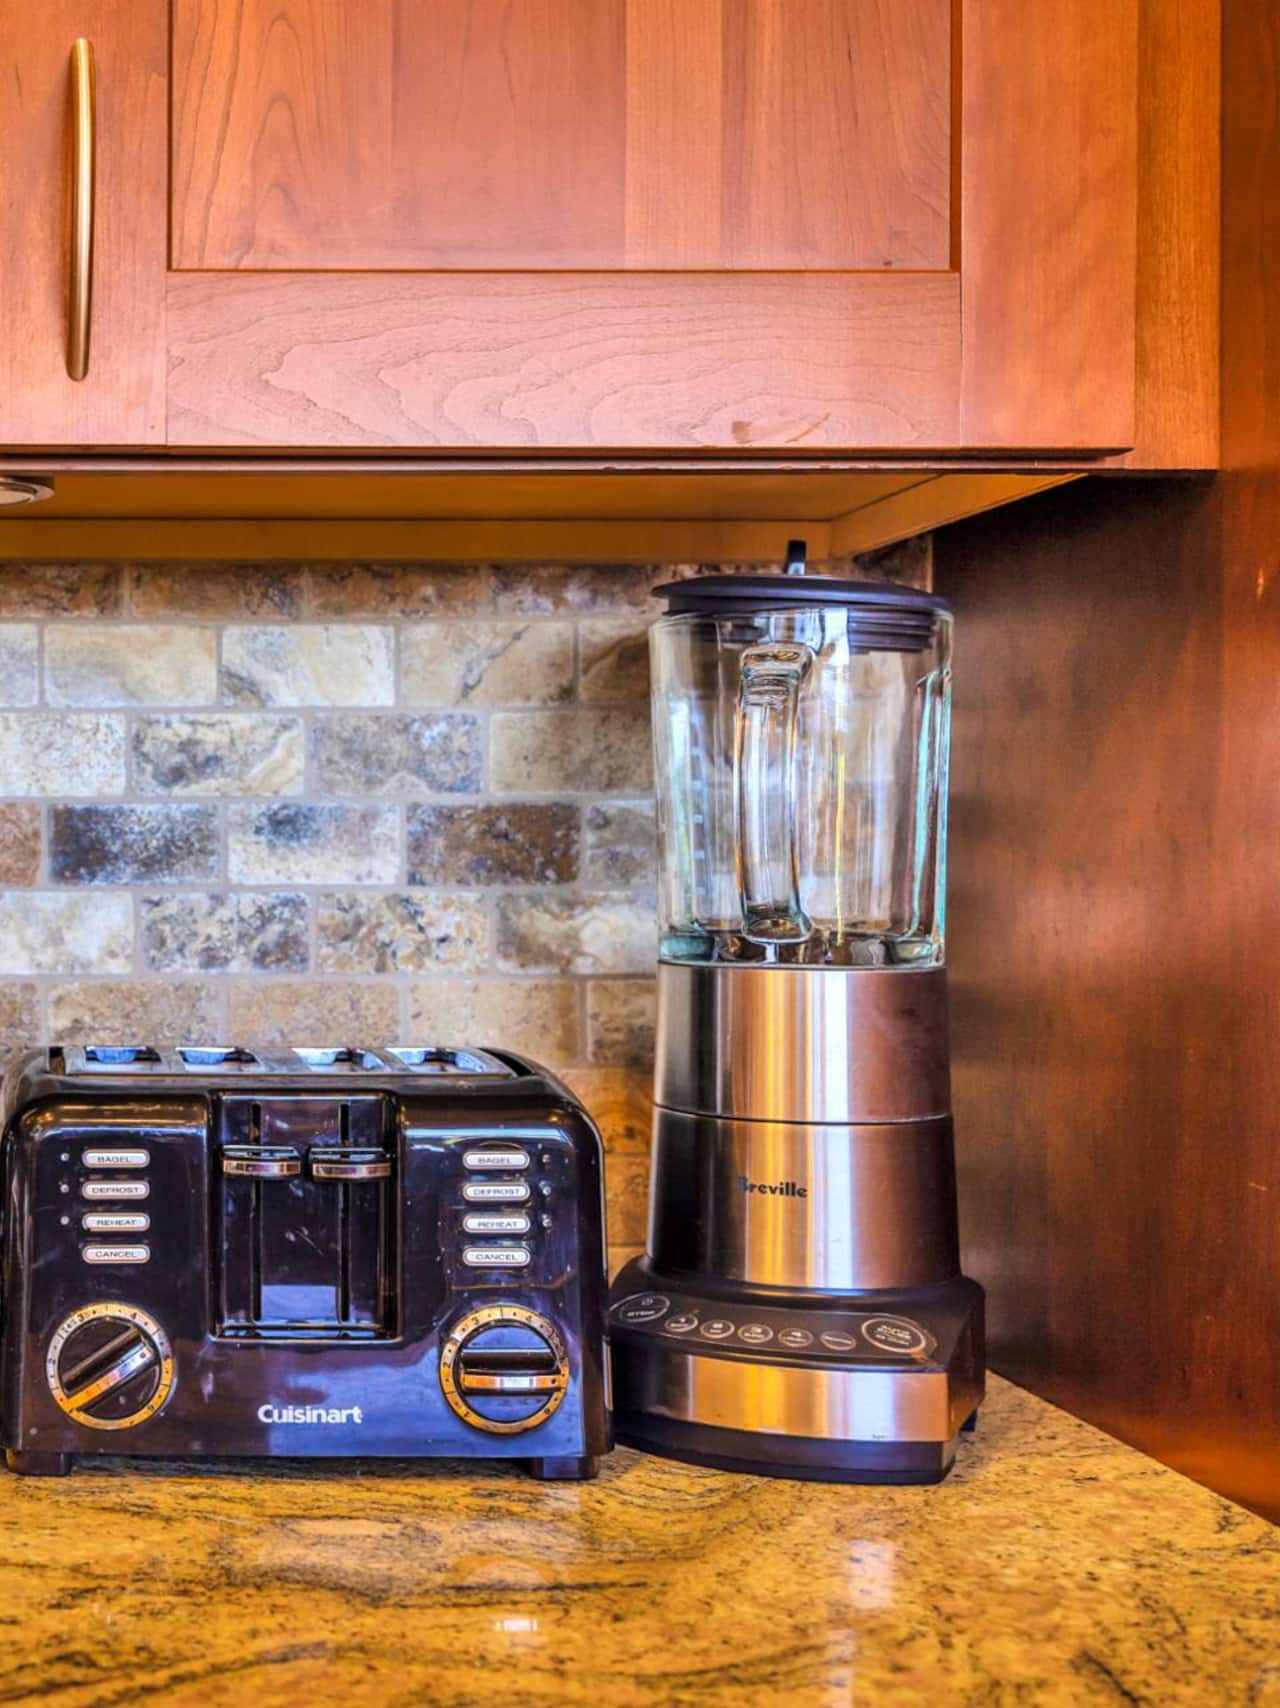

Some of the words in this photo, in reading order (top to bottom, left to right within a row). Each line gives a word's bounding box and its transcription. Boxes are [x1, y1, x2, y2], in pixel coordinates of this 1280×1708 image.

[96, 1155, 131, 1163] BAGEL
[477, 1156, 513, 1164] BAGEL
[91, 1186, 140, 1194] DEFROST
[736, 1176, 808, 1198] Breville
[96, 1218, 137, 1226] REHEAT
[95, 1250, 138, 1258] CANCEL
[475, 1253, 519, 1261] CANCEL
[257, 1404, 363, 1424] Cuisinart
